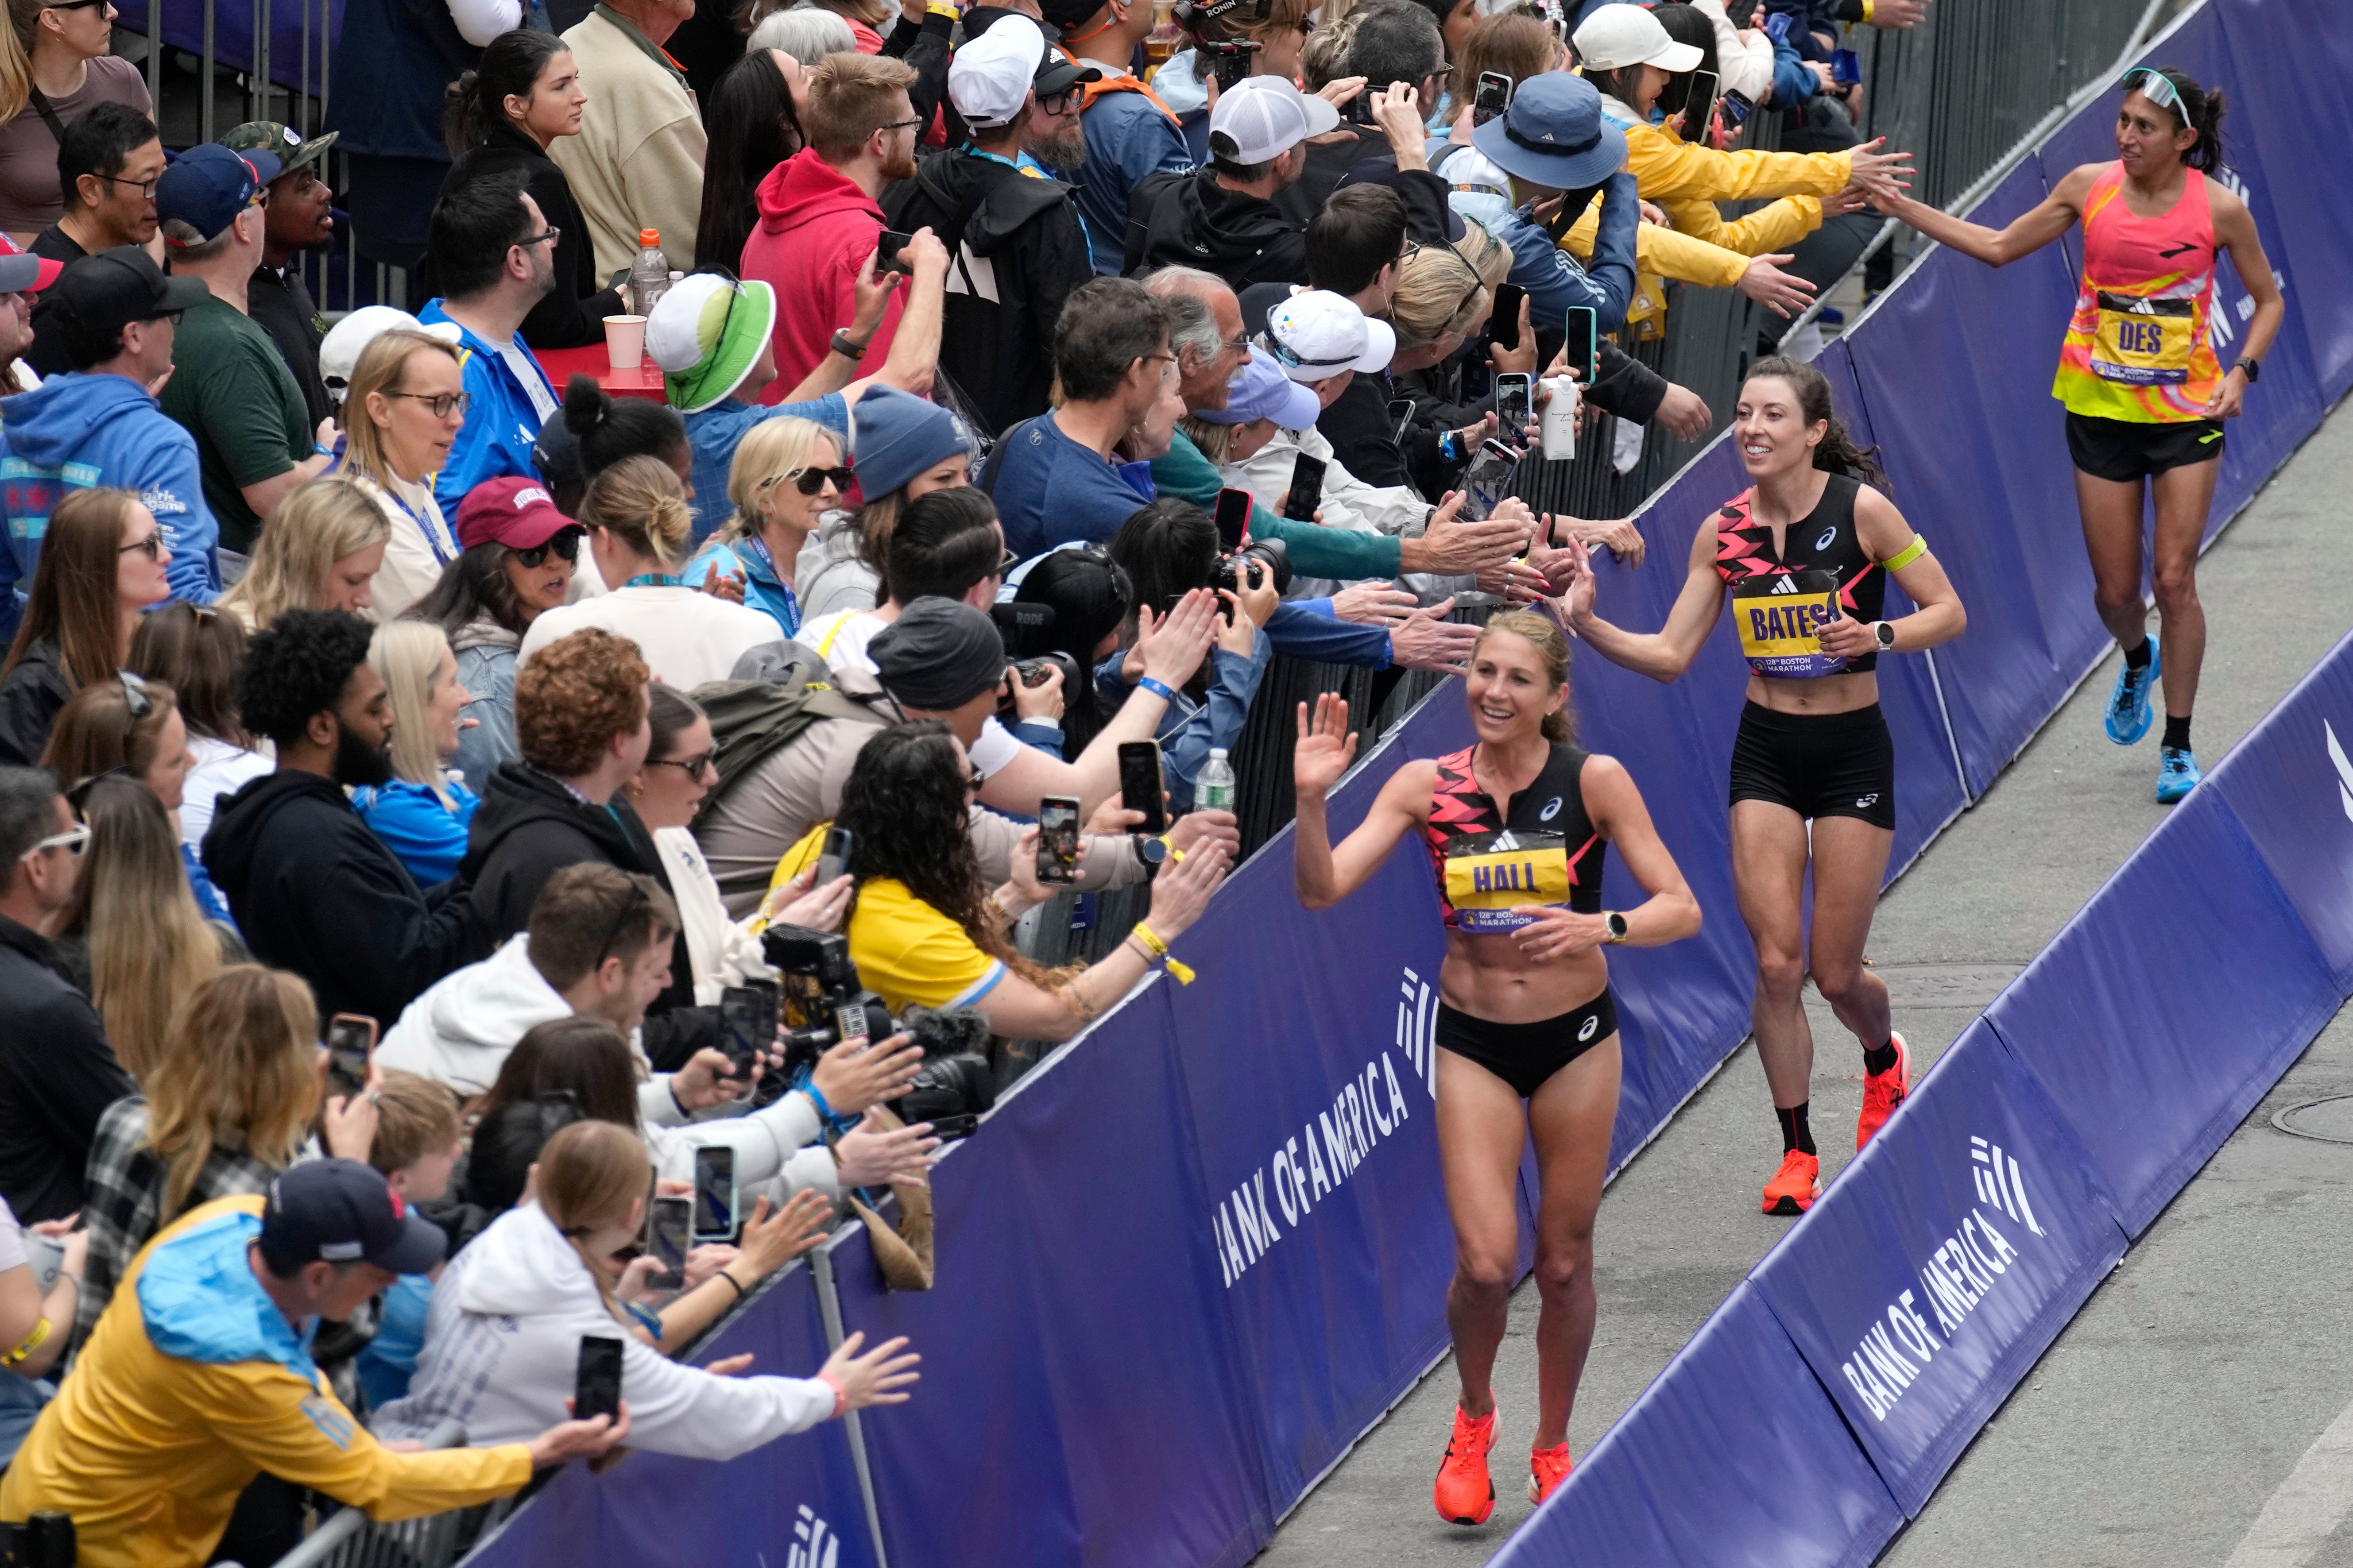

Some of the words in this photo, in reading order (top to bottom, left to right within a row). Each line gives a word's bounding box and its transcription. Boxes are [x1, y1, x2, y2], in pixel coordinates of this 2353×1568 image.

[1206, 0, 1236, 17] RONIN
[2119, 321, 2162, 354] DES
[147, 500, 186, 514] game
[1750, 603, 1826, 641] BATES
[1767, 663, 1811, 672] MARATHON
[1780, 657, 1811, 665] BOSTON
[1473, 862, 1541, 894] HALL
[1480, 917, 1532, 926] MARATHON
[849, 1007, 866, 1035] NEWS
[1273, 1136, 1311, 1227] OF
[1306, 1051, 1409, 1202] AMERICA
[1842, 1321, 1920, 1422] BANK
[1888, 1289, 1942, 1363] OF
[1919, 1208, 2018, 1339] AMERICA
